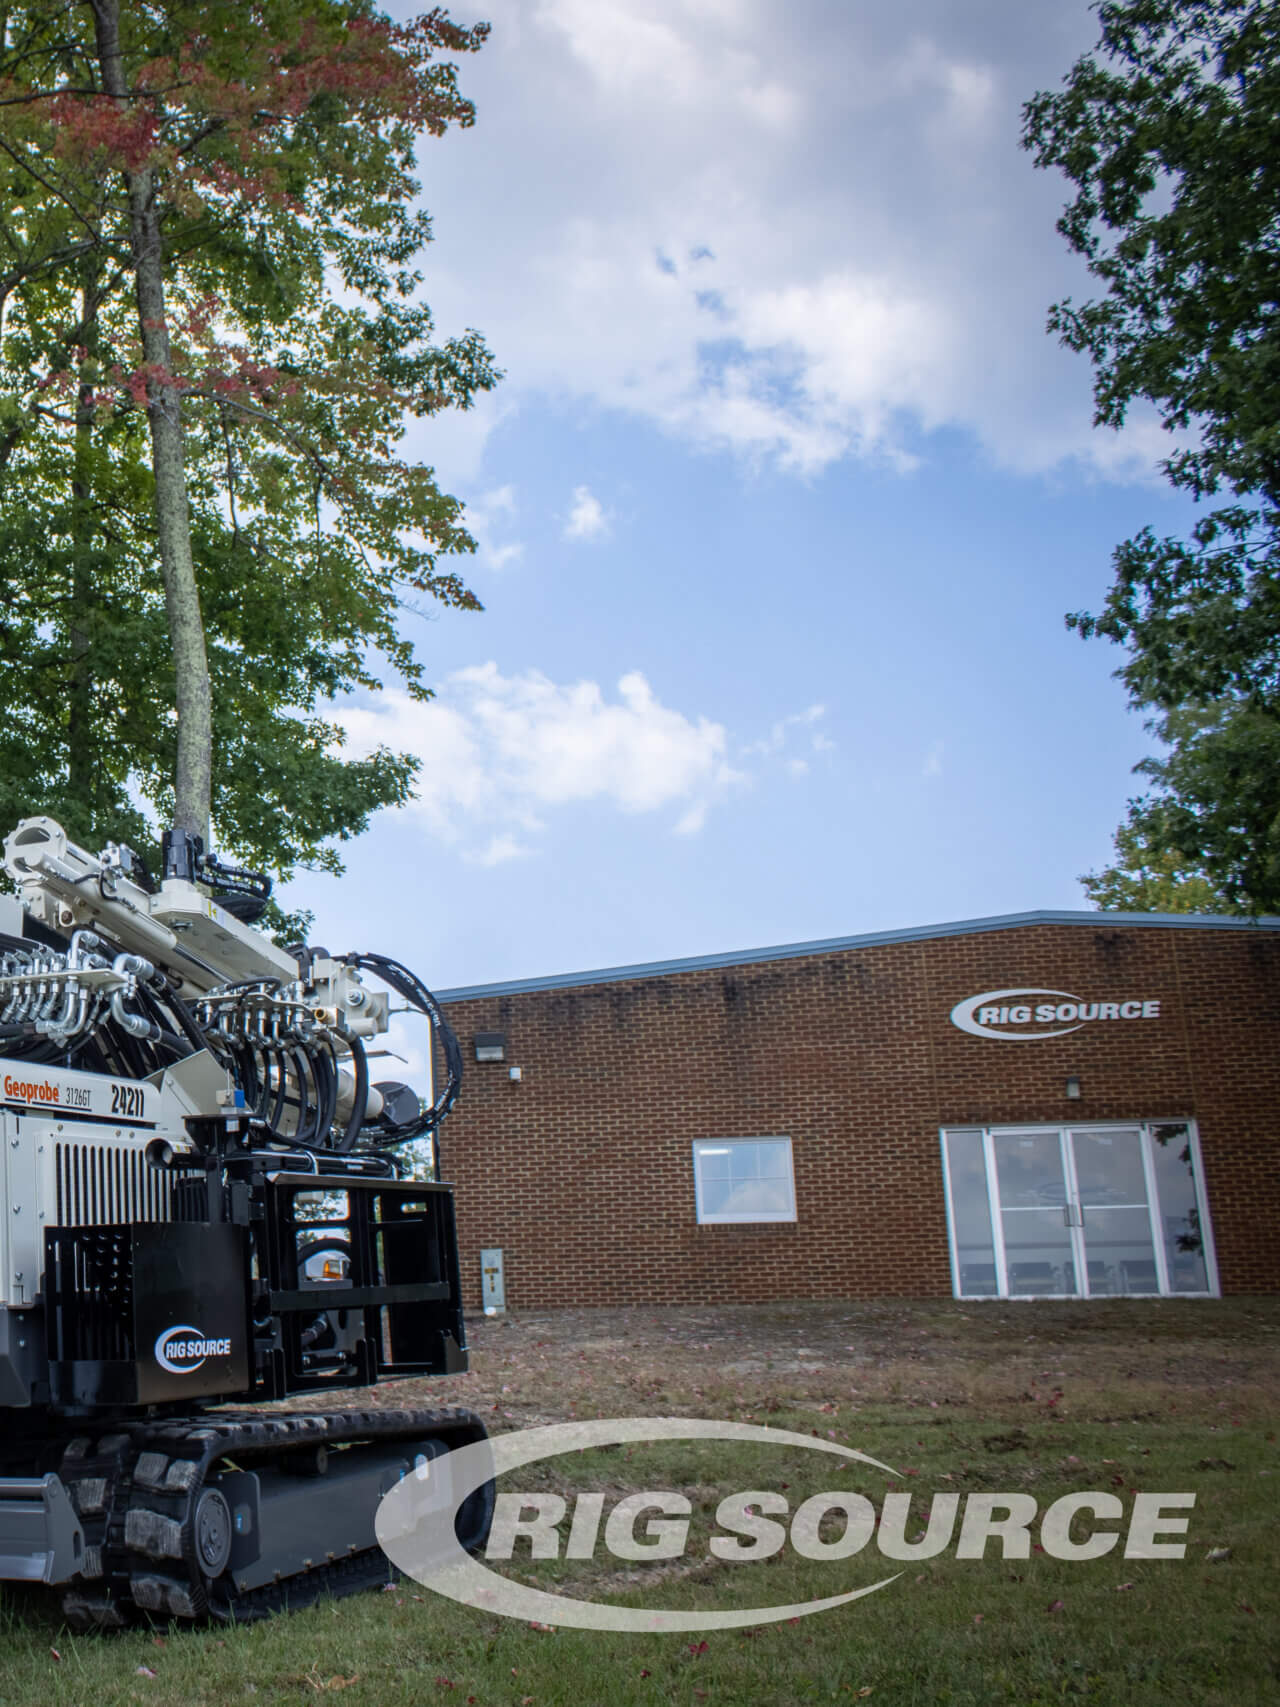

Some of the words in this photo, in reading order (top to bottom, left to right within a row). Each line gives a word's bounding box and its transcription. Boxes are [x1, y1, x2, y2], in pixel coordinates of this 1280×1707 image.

[978, 1006, 1032, 1024] RIG
[1034, 1002, 1160, 1022] SOURCE
[65, 1087, 92, 1107] 3126GT
[111, 1083, 144, 1117] 24211
[166, 1341, 186, 1359] RIG
[187, 1339, 231, 1358] SOURCE
